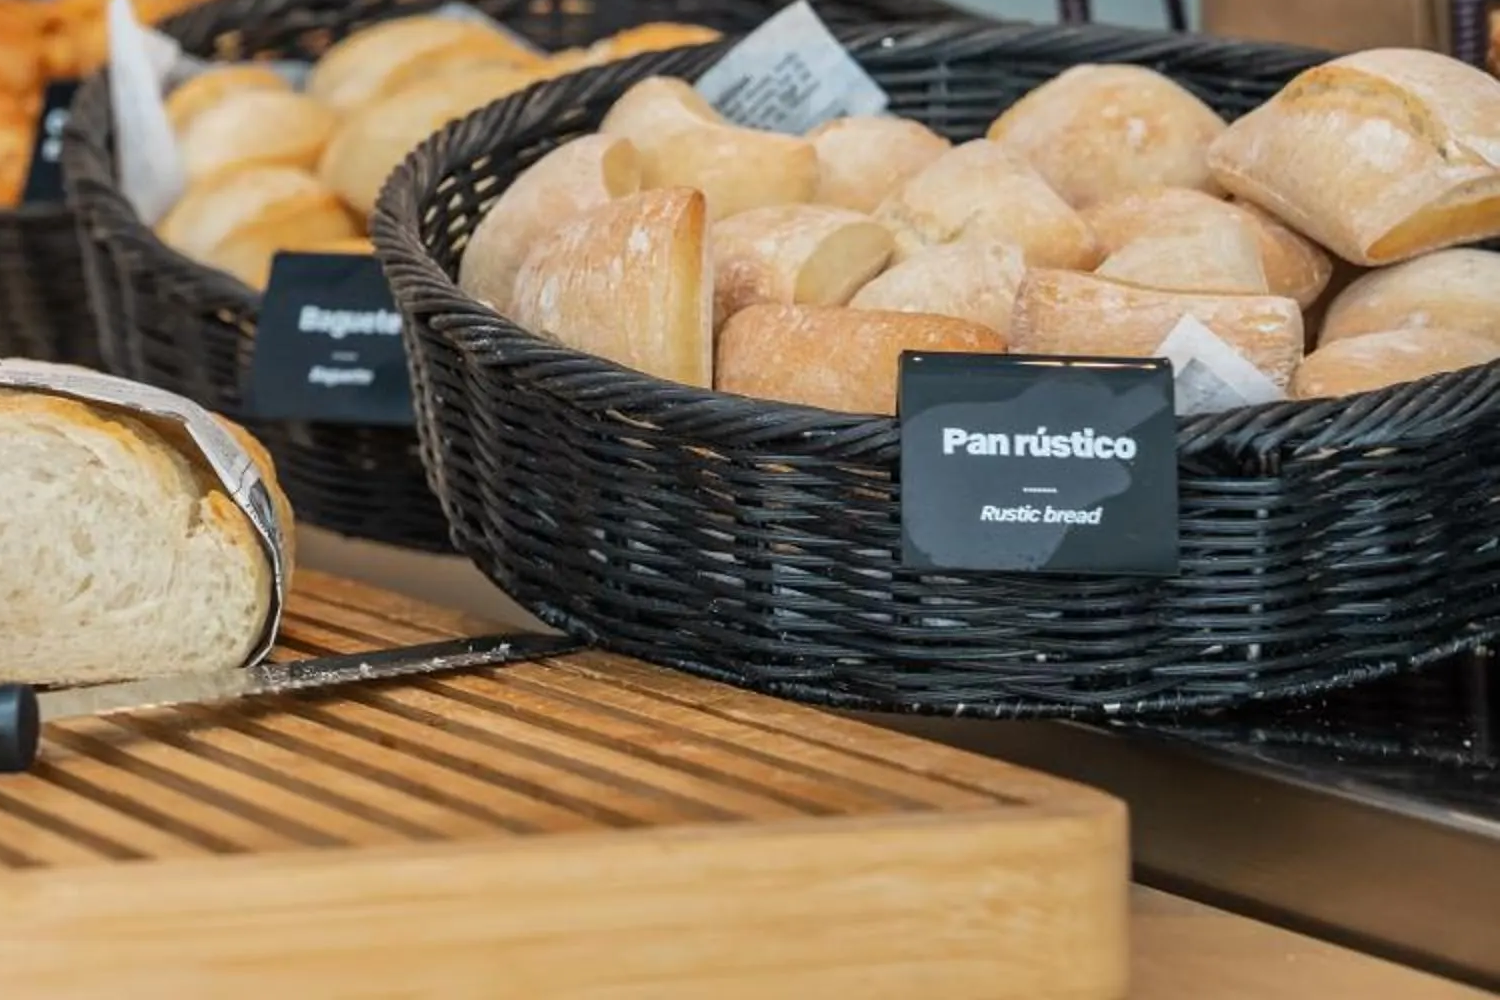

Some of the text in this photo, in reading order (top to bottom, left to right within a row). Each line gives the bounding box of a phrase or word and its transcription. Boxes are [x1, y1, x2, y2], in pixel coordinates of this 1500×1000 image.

[943, 426, 1138, 460] Pan rústico
[980, 504, 1103, 525] Rustic bread
